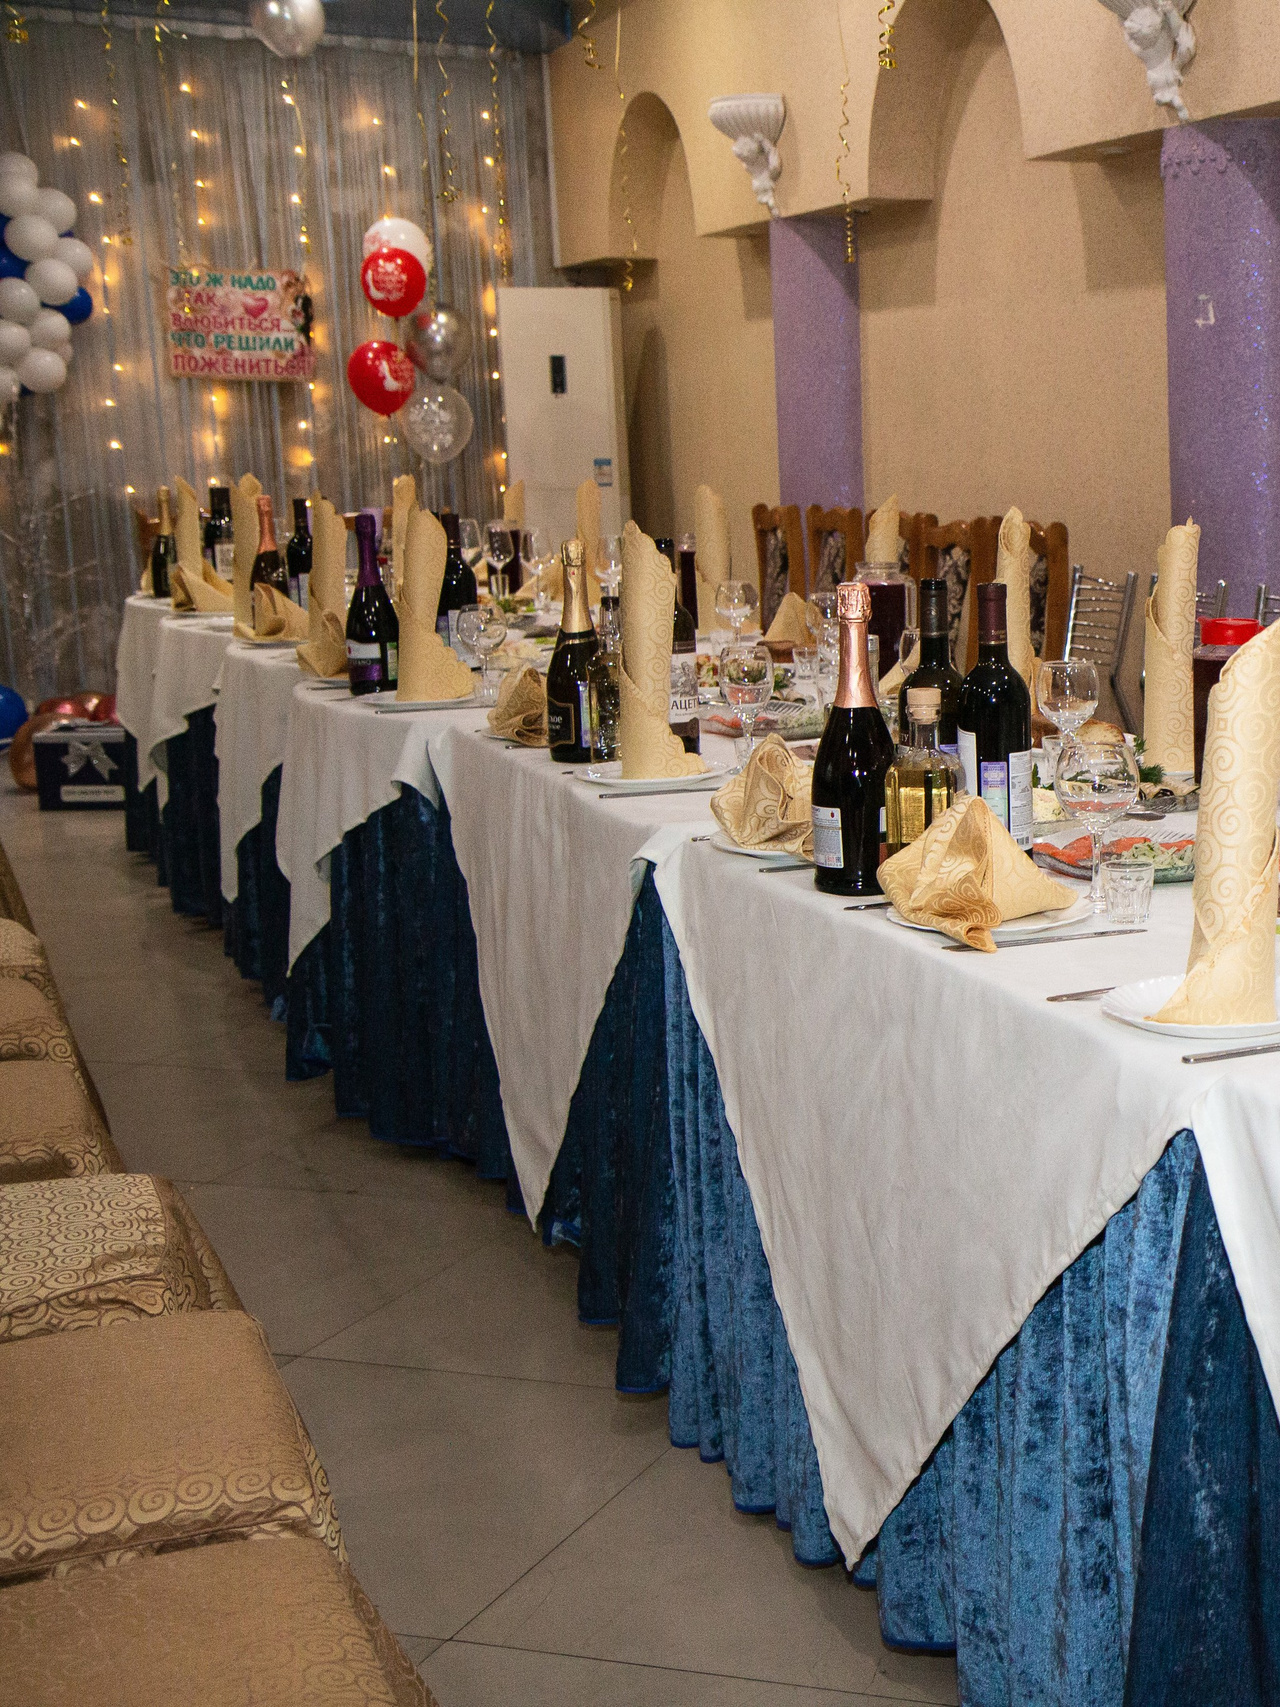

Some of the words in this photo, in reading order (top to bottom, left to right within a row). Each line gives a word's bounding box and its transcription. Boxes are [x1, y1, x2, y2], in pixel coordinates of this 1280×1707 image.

[205, 273, 223, 287] Ж
[231, 274, 276, 291] НАДО
[170, 331, 206, 348] ЧТО
[213, 333, 295, 351] РЕШИЛИ
